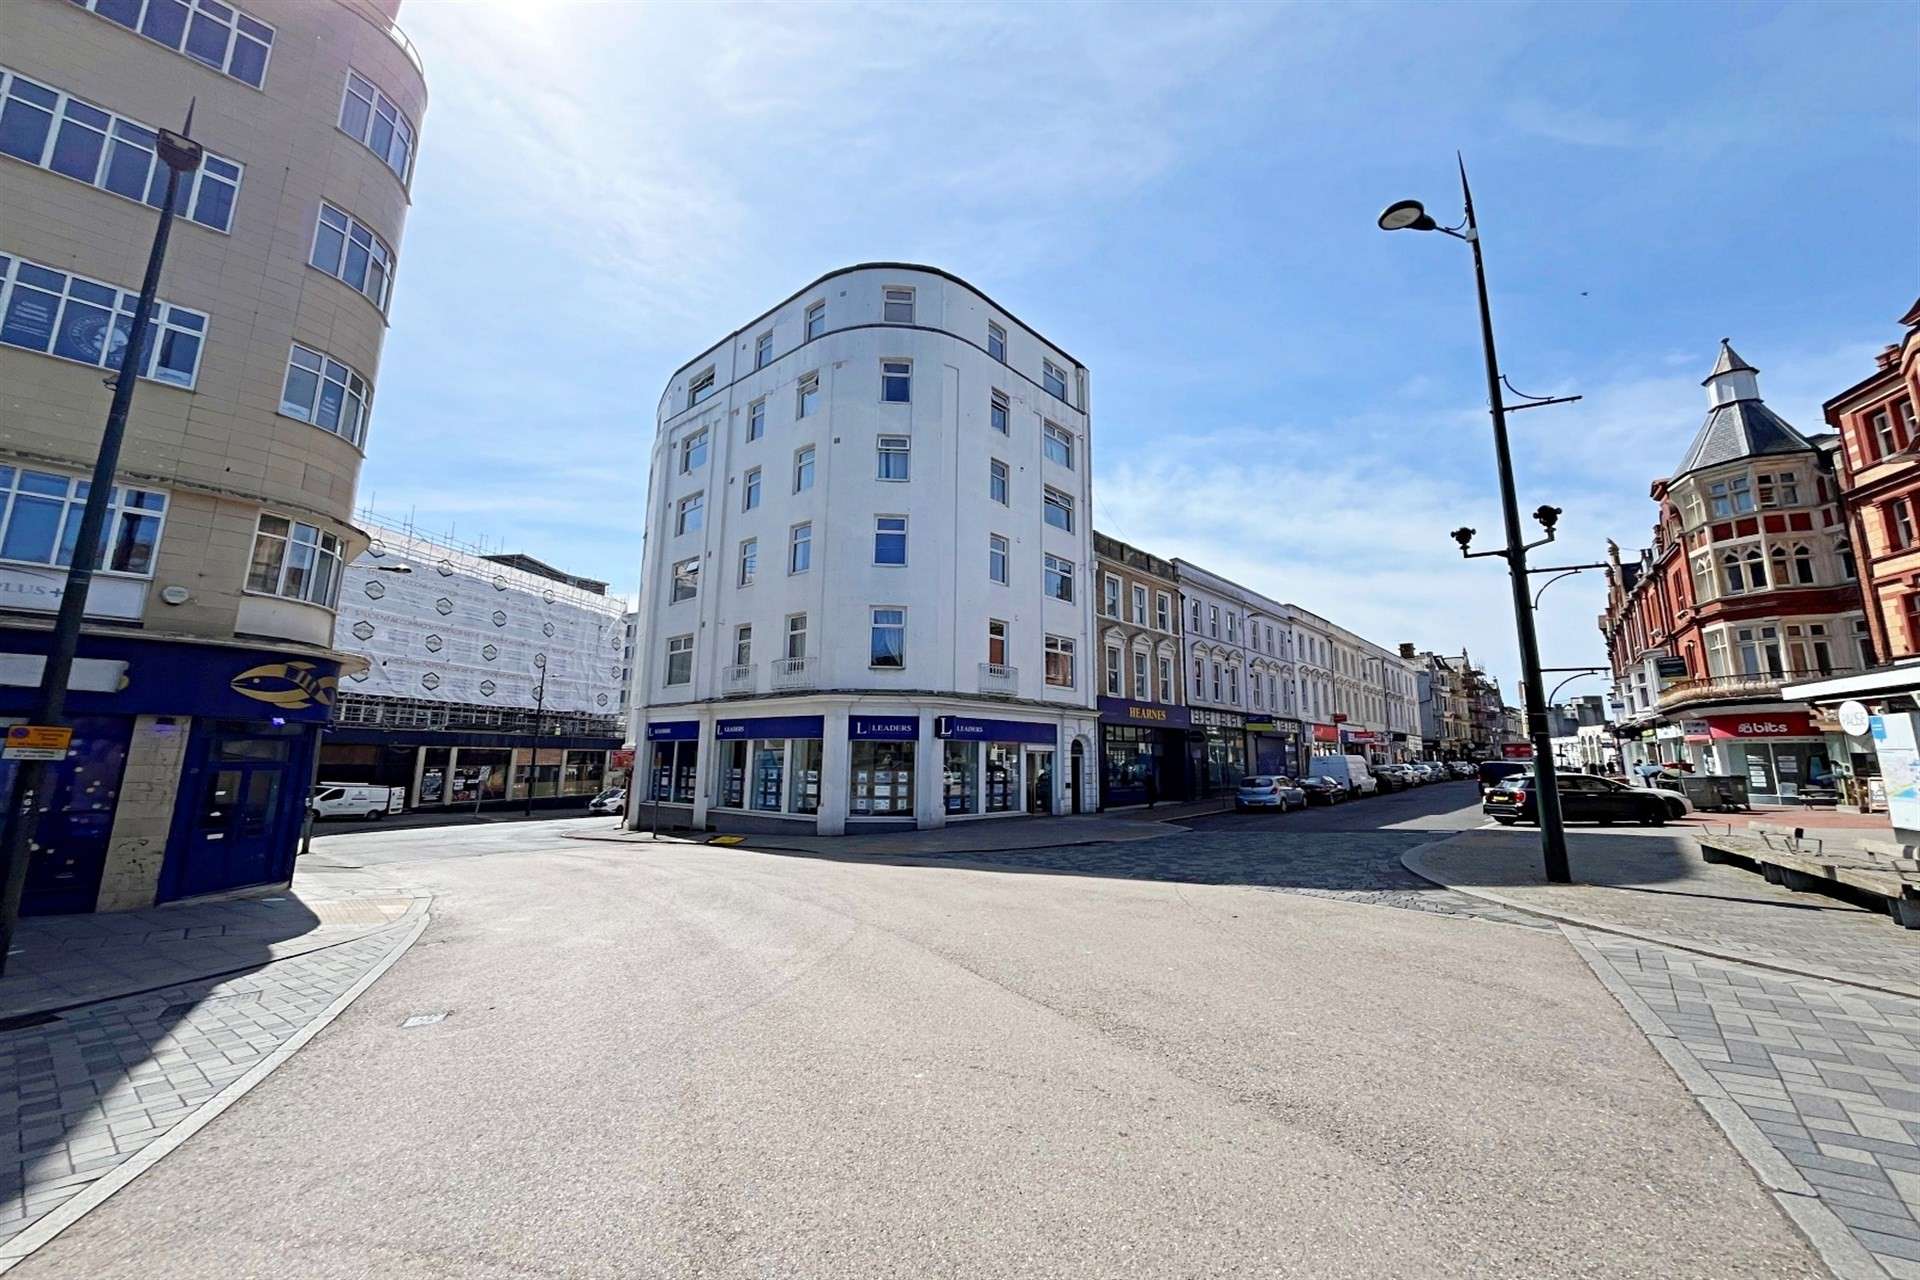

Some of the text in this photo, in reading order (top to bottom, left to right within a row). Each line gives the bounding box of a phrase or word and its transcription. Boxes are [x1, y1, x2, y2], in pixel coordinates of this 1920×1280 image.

[0, 582, 64, 598] LUS+
[1129, 706, 1167, 721] HEARNES
[956, 725, 983, 733] LEADERS
